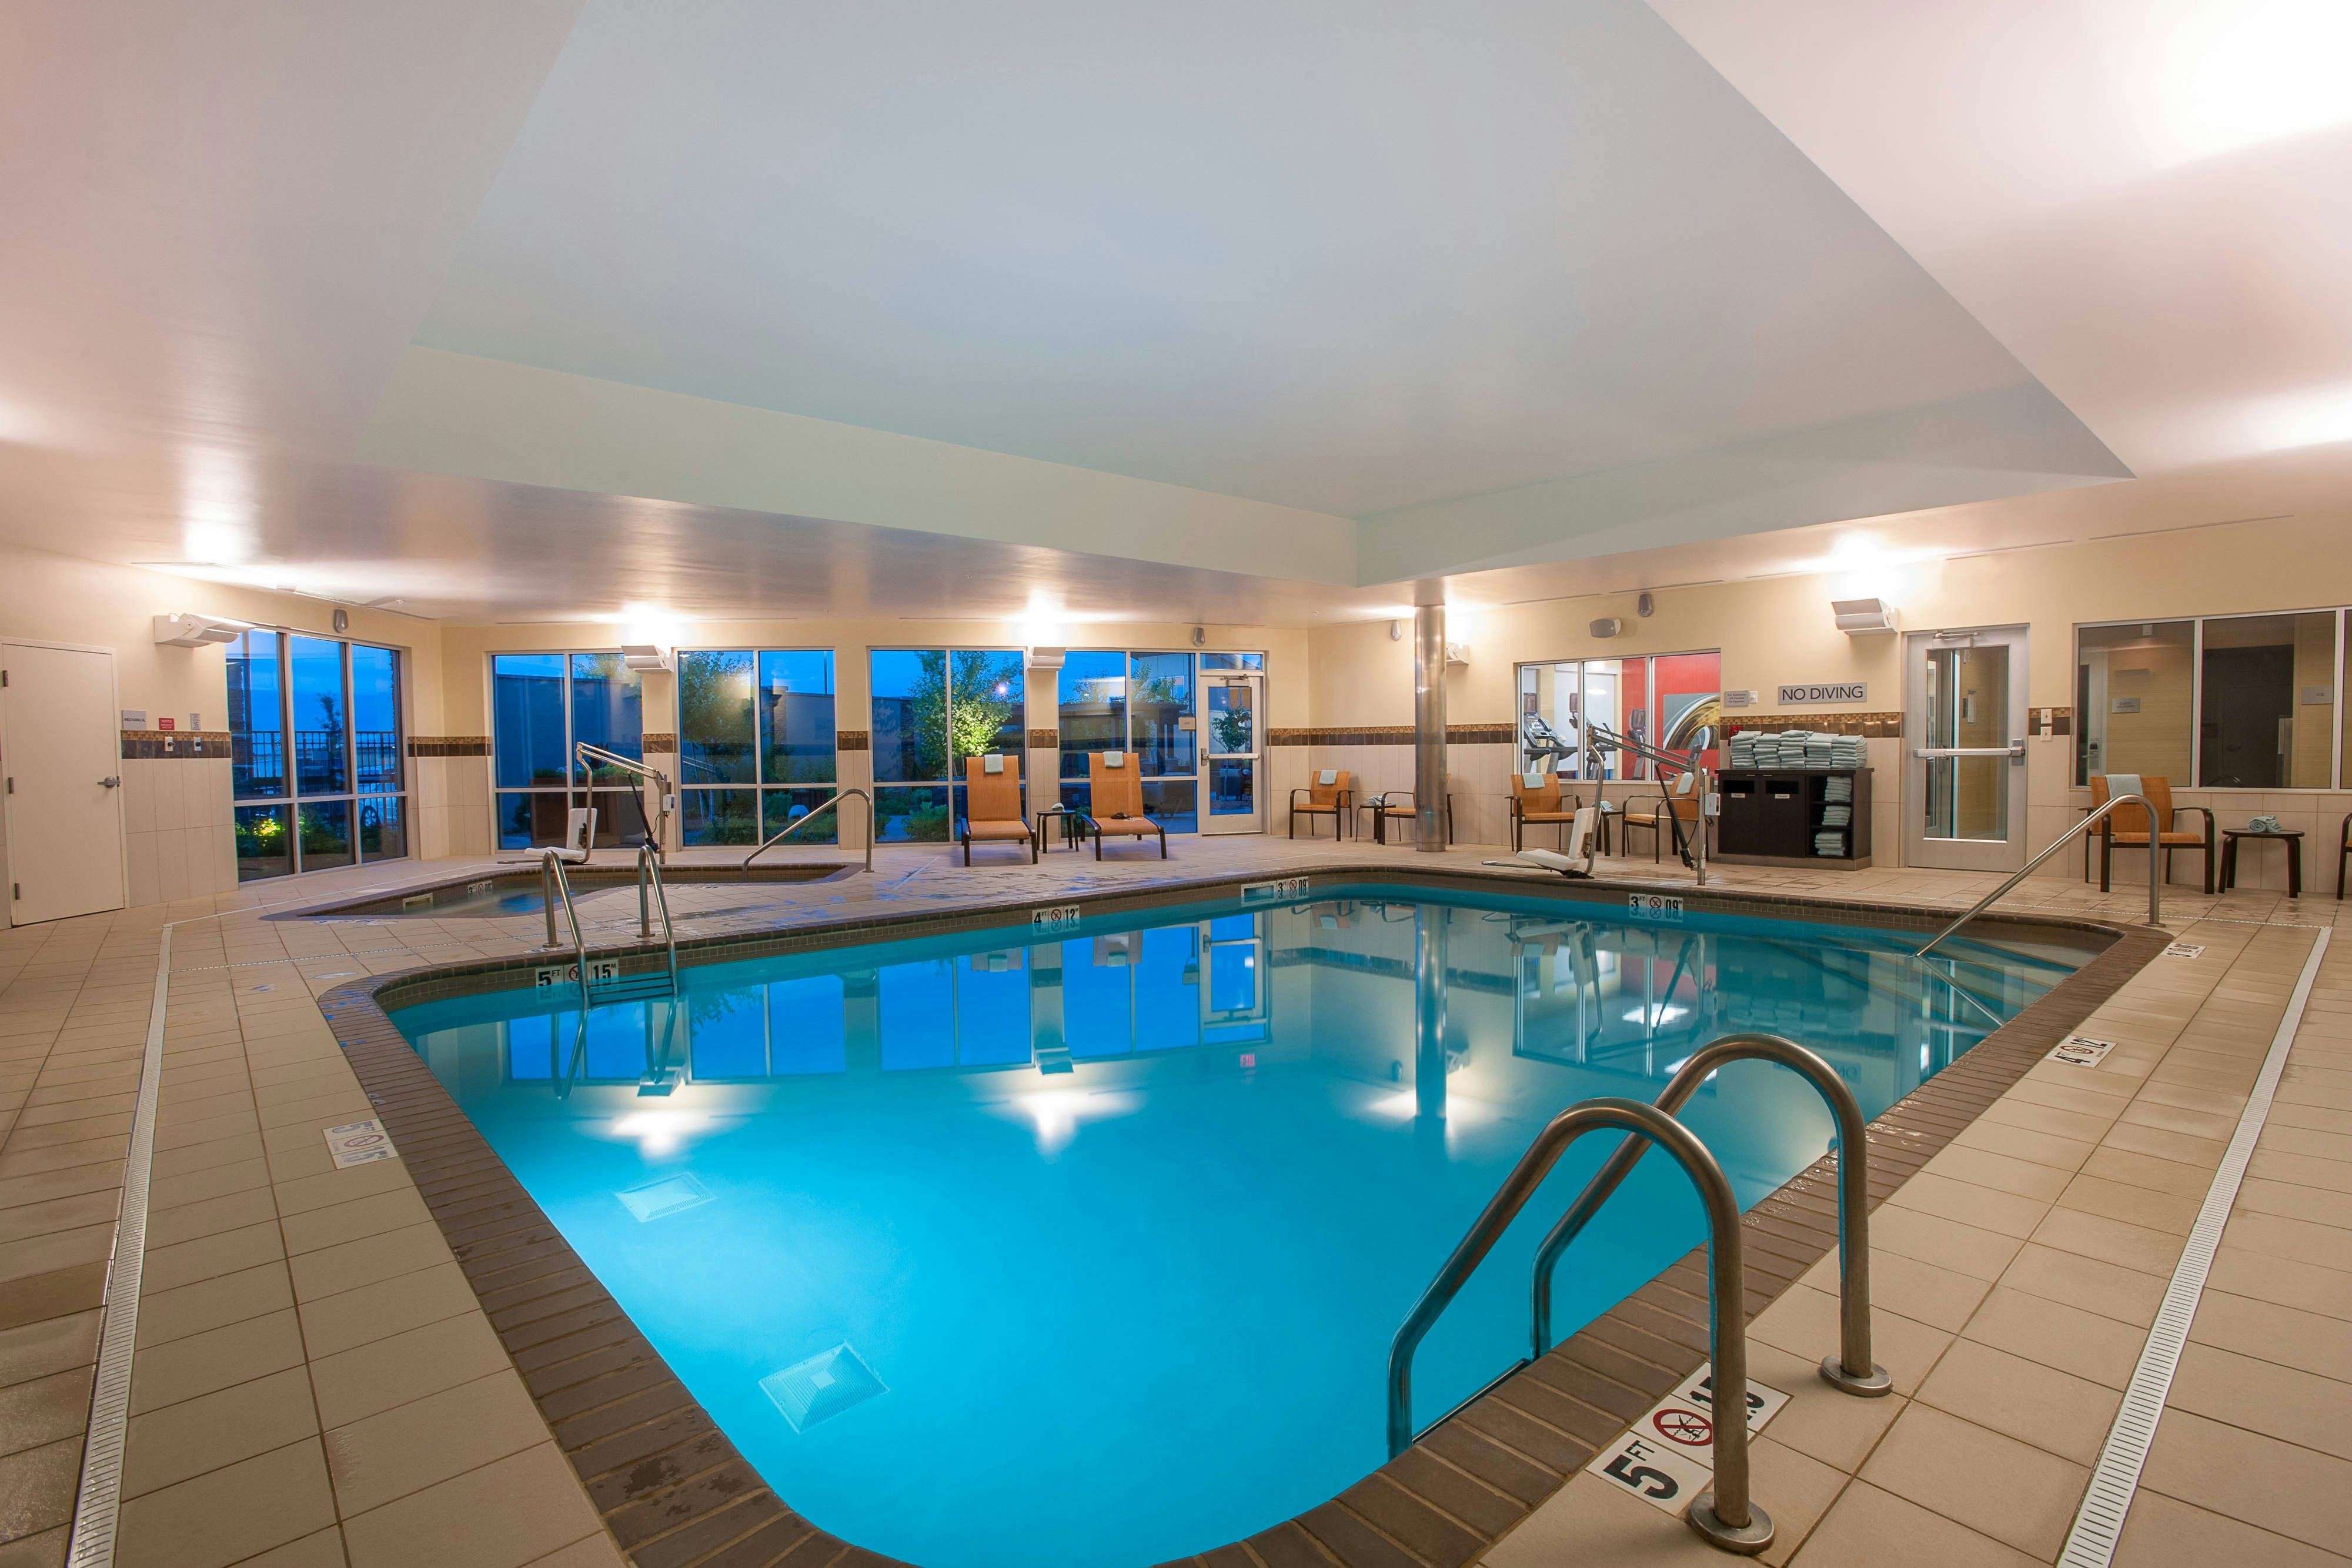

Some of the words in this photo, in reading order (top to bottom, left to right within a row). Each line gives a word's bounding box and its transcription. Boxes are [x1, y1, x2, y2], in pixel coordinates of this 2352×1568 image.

[1782, 688, 1806, 700] NO
[1810, 686, 1863, 700] DIVING
[1631, 896, 1639, 907] 3
[1034, 912, 1042, 923] 4
[1065, 908, 1075, 920] 12
[538, 971, 552, 987] 5
[593, 964, 612, 980] 15
[2054, 1055, 2091, 1064] 4
[332, 1121, 373, 1134] 5
[1624, 1439, 1655, 1462] FT
[1603, 1454, 1679, 1499] 5
